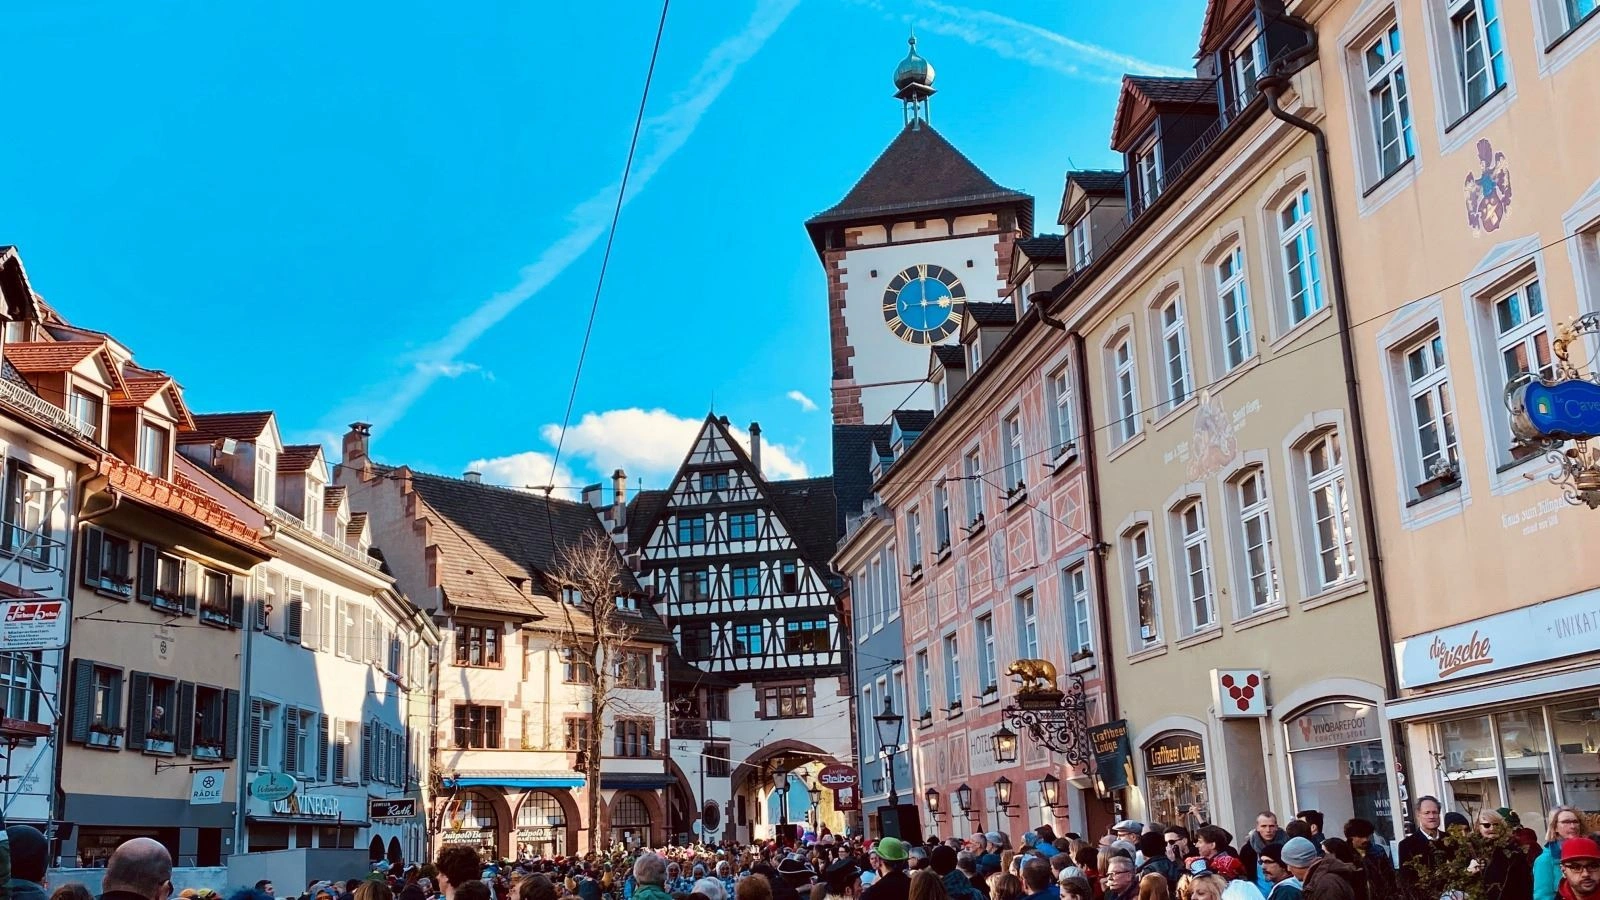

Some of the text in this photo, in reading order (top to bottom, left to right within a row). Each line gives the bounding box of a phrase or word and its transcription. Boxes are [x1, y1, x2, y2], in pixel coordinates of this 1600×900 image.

[1554, 609, 1600, 639] UNIKAT
[1429, 630, 1491, 670] die nische
[1313, 717, 1367, 734] VIVOBAREFOOT
[1091, 726, 1127, 743] Craftbeer
[1095, 740, 1118, 754] Lodge
[1151, 741, 1201, 766] Craftbeer Lodge
[387, 803, 412, 816] Rath
